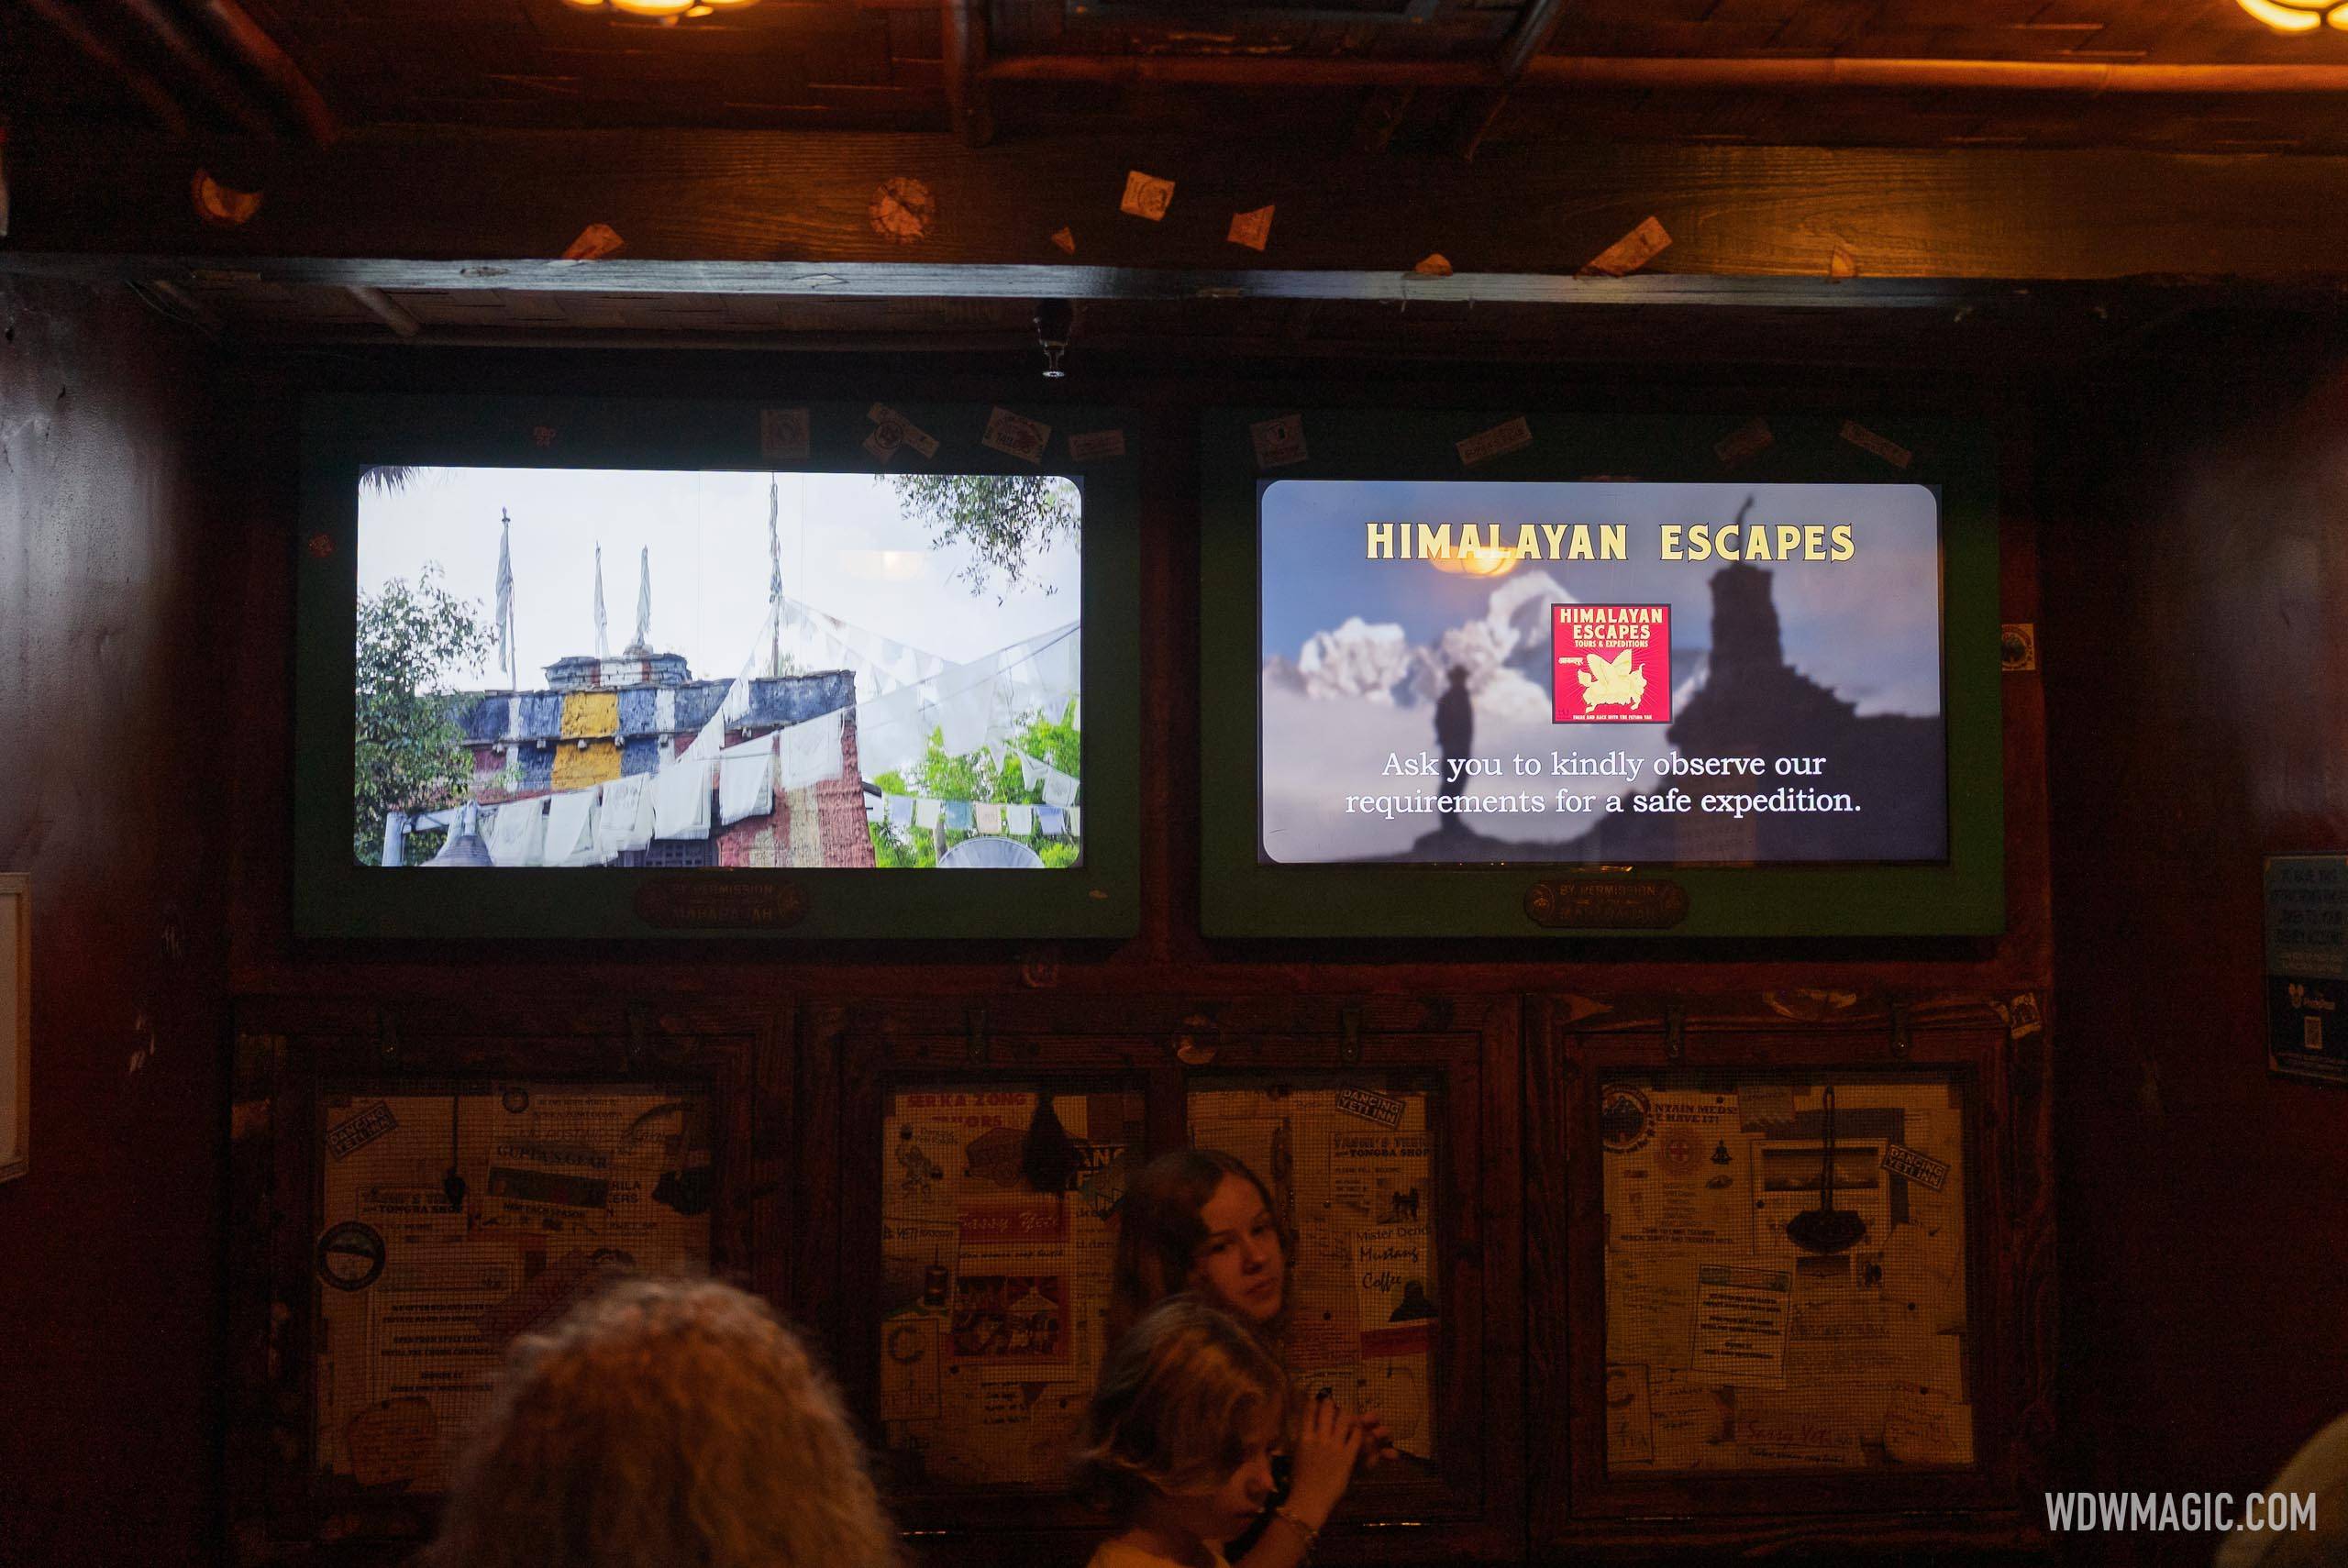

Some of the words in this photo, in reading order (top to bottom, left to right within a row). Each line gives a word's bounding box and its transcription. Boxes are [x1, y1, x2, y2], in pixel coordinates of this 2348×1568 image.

[1366, 522, 1629, 562] HIMALAYAN
[1660, 523, 1856, 564] ESCAPES
[1560, 608, 1663, 624] HIMALAYAN
[1573, 624, 1651, 640] ESCAPES
[1606, 640, 1649, 648] EXPEDITIONS
[1381, 752, 1440, 777] Ask
[1447, 757, 1503, 784] you
[1513, 756, 1542, 777] to
[1551, 750, 1644, 784] kindly
[1653, 751, 1767, 777] observe
[1775, 757, 1826, 777] our
[1346, 792, 1545, 821] requirements
[1556, 789, 1596, 813] for
[1605, 795, 1622, 813] a
[1633, 789, 1692, 813] safe
[1700, 790, 1862, 821] expedition.
[1340, 1097, 1369, 1114] YETI
[1343, 1089, 1401, 1114] DANCING
[1349, 1148, 1397, 1157] TONGBA
[1400, 1148, 1431, 1157] SHOP
[1890, 1148, 1944, 1176] DANCING
[1356, 1229, 1394, 1242] Mister
[1359, 1246, 1419, 1263] Mustang
[1362, 1271, 1402, 1293] Coffee
